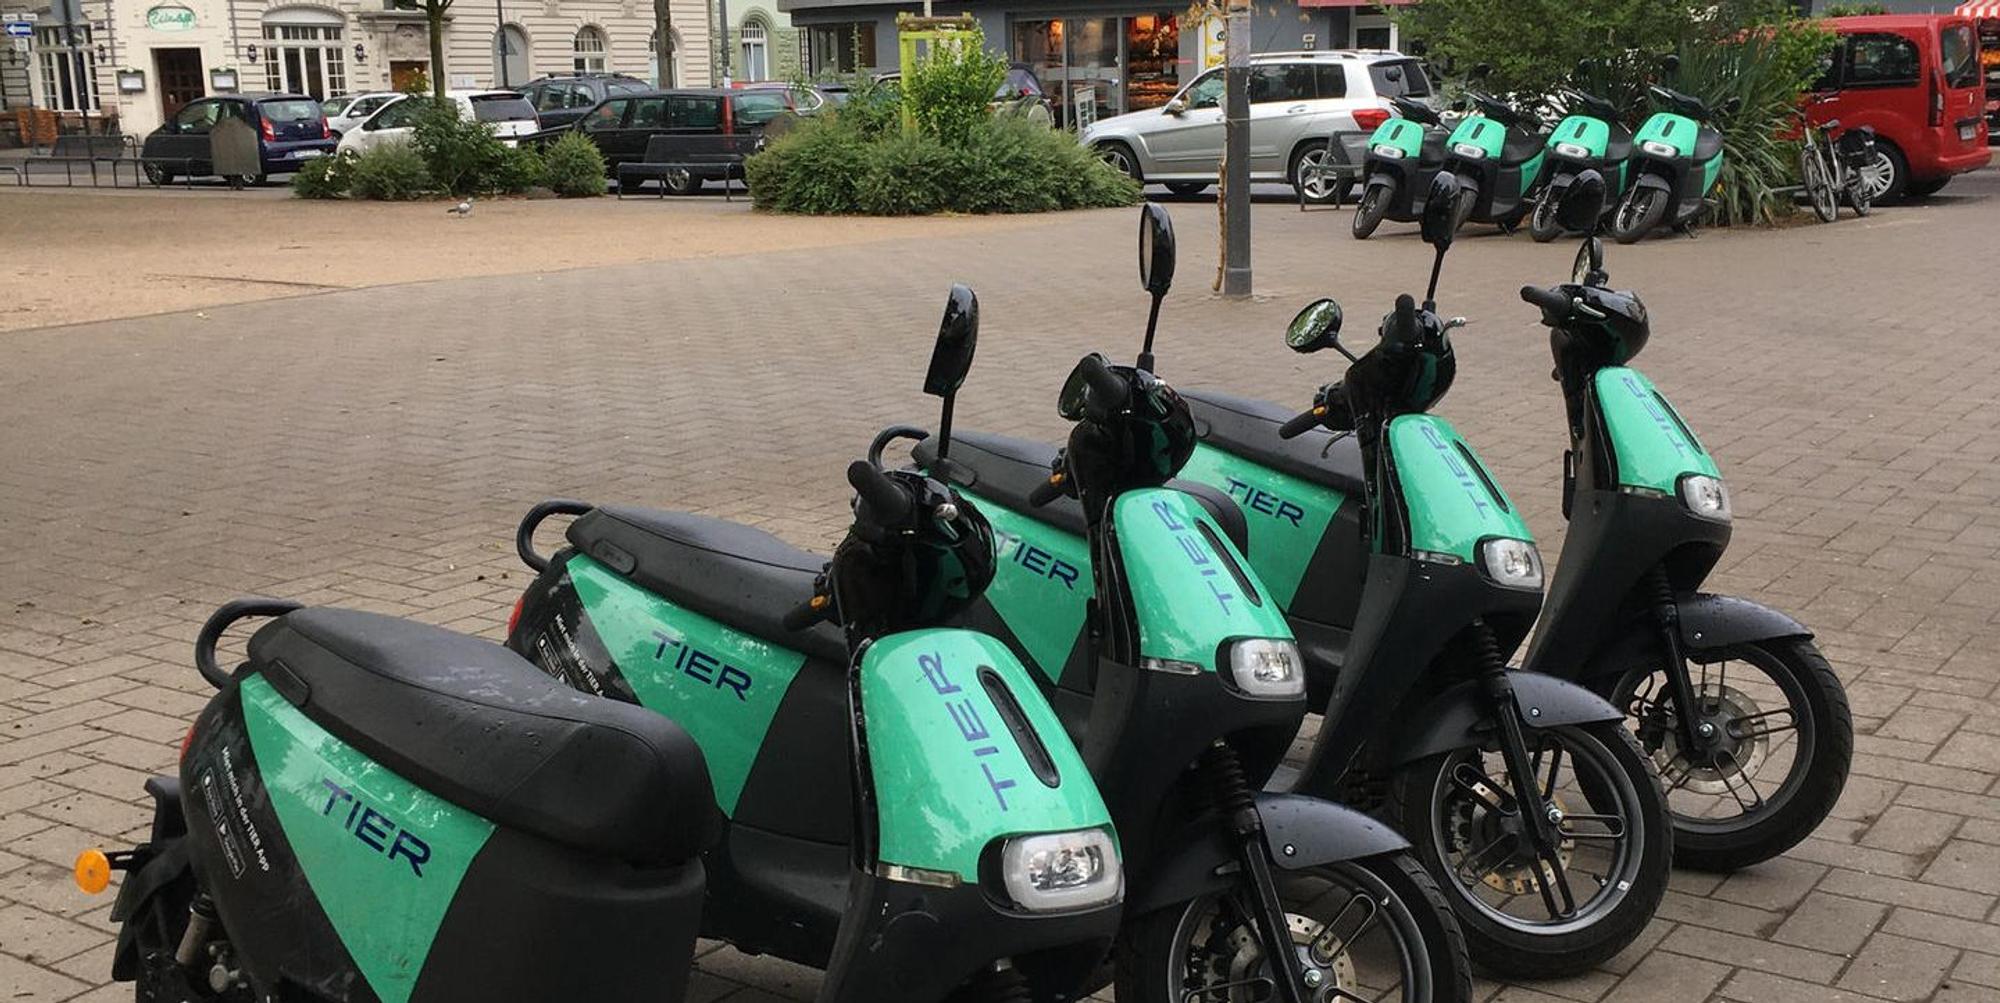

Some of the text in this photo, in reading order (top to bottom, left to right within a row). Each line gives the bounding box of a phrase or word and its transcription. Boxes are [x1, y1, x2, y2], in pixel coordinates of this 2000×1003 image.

[1622, 376, 1684, 458] TIER
[1226, 476, 1304, 528] TIER
[1420, 425, 1488, 520] TIER
[996, 528, 1080, 591] TIER
[1151, 500, 1233, 617] TIER
[586, 671, 600, 692] TIER
[652, 629, 752, 702] TIER
[917, 650, 1017, 813] TIER
[247, 822, 261, 850] TIER
[256, 848, 270, 871] App
[322, 777, 431, 878] TIER
